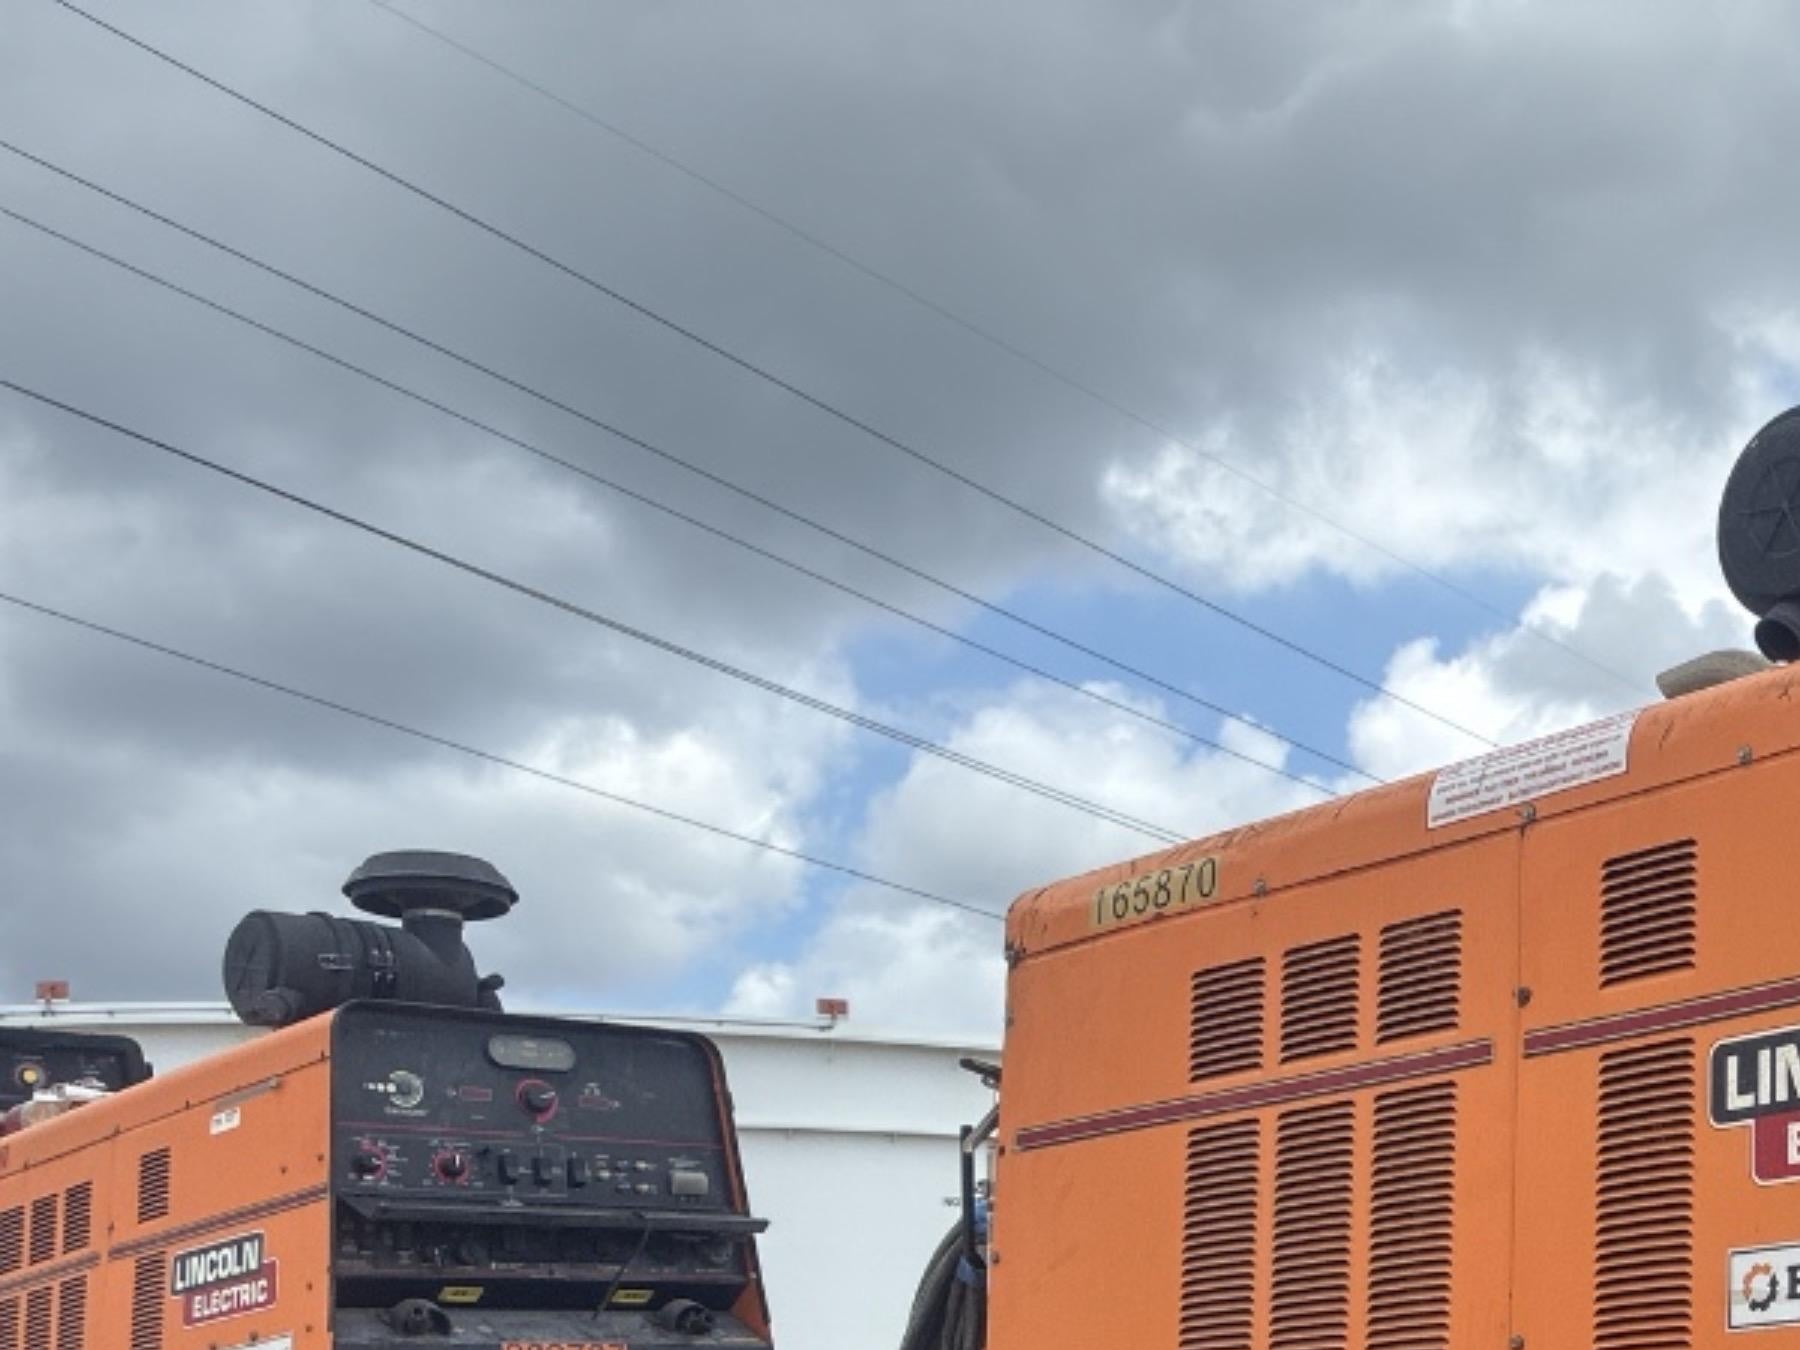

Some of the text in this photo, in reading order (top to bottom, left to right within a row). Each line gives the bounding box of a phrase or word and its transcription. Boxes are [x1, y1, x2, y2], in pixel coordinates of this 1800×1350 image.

[1096, 857, 1217, 926] 165870
[174, 1238, 260, 1291] LINCOLN
[191, 1278, 268, 1319] ELECTRIC
